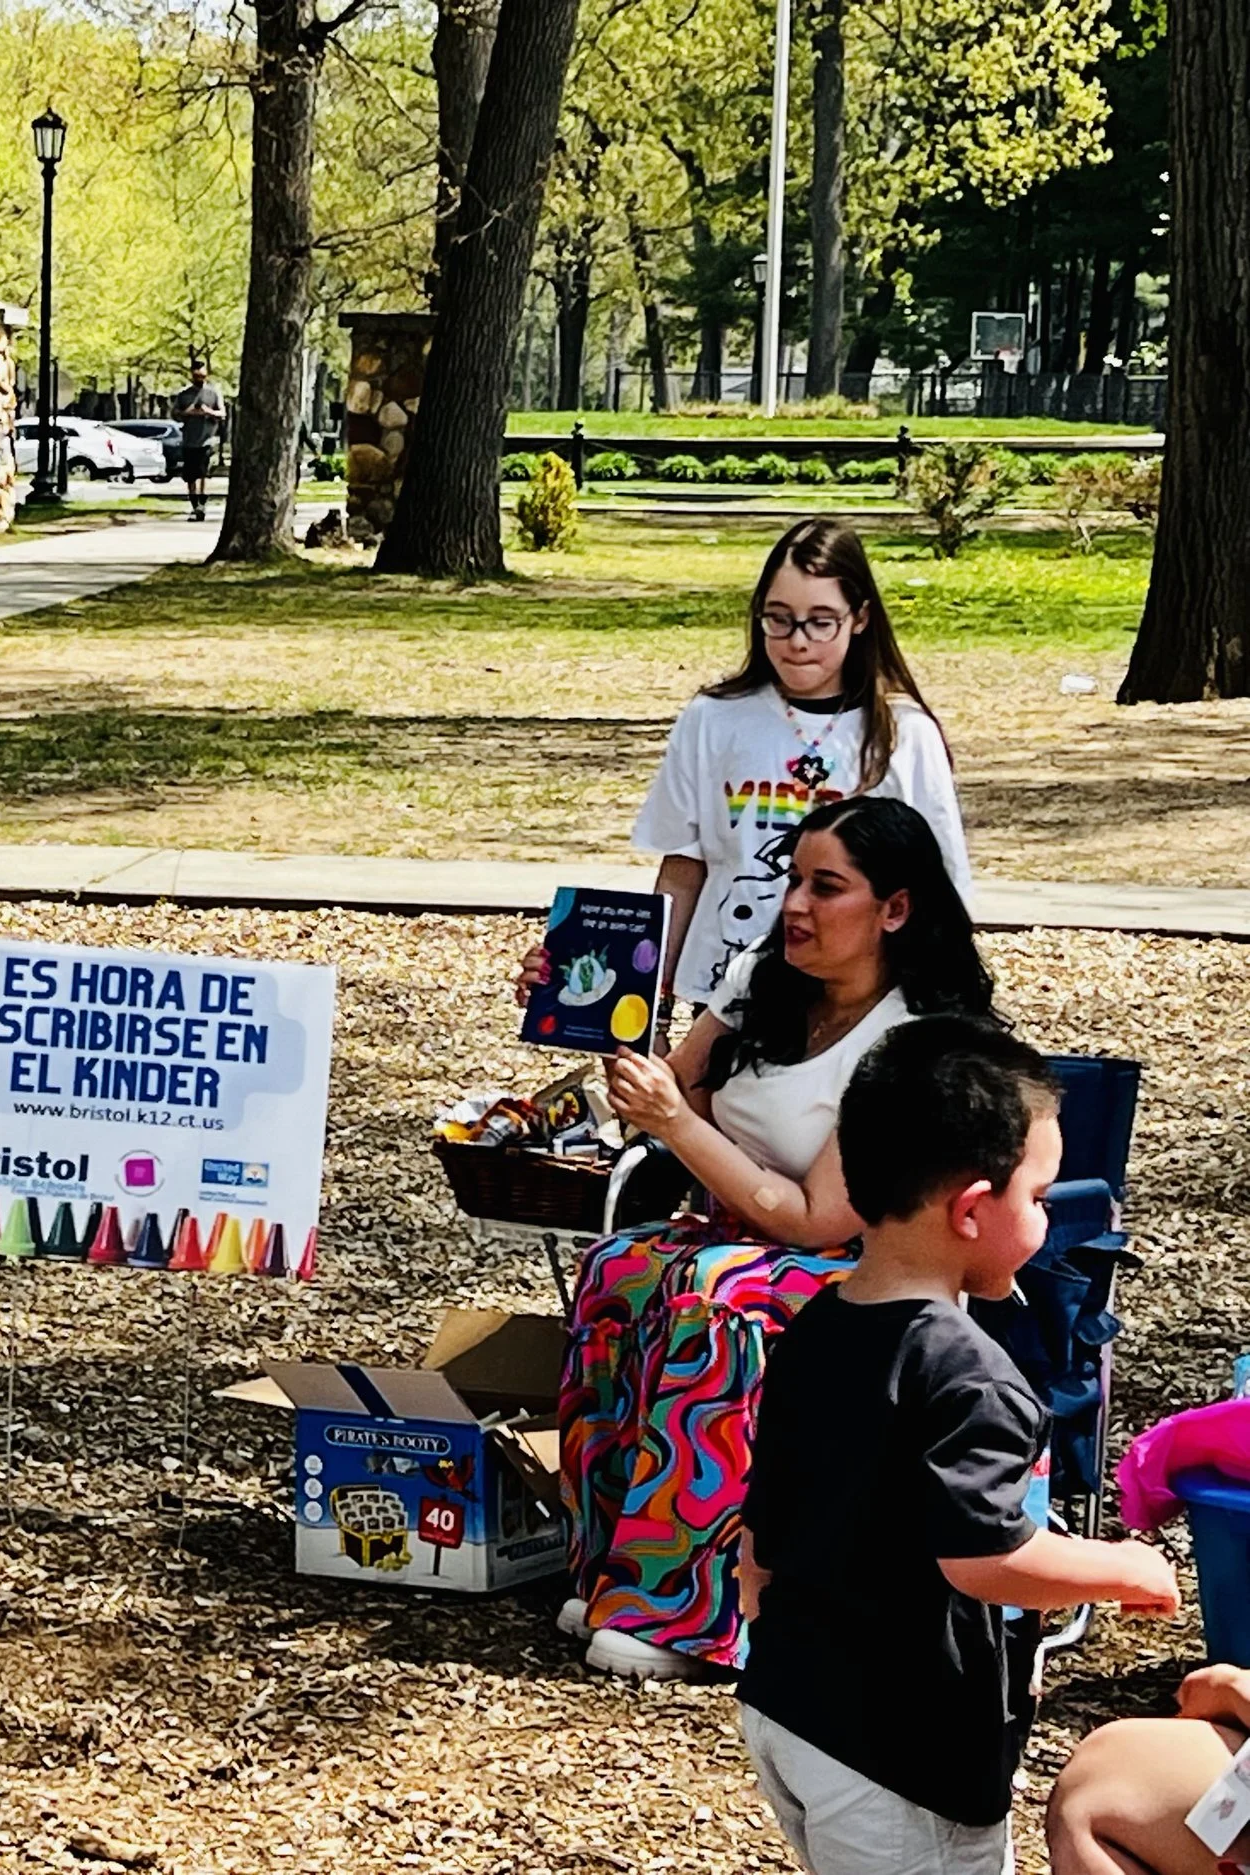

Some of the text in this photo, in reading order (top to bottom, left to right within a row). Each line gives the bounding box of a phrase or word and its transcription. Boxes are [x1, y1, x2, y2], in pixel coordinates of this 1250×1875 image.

[3, 957, 256, 1016] ES HORA DE
[216, 1021, 269, 1064] EN
[10, 1052, 221, 1108] EL KINDER
[13, 1102, 225, 1130] www.bristol.k12.ct.us
[425, 1507, 455, 1531] 40
